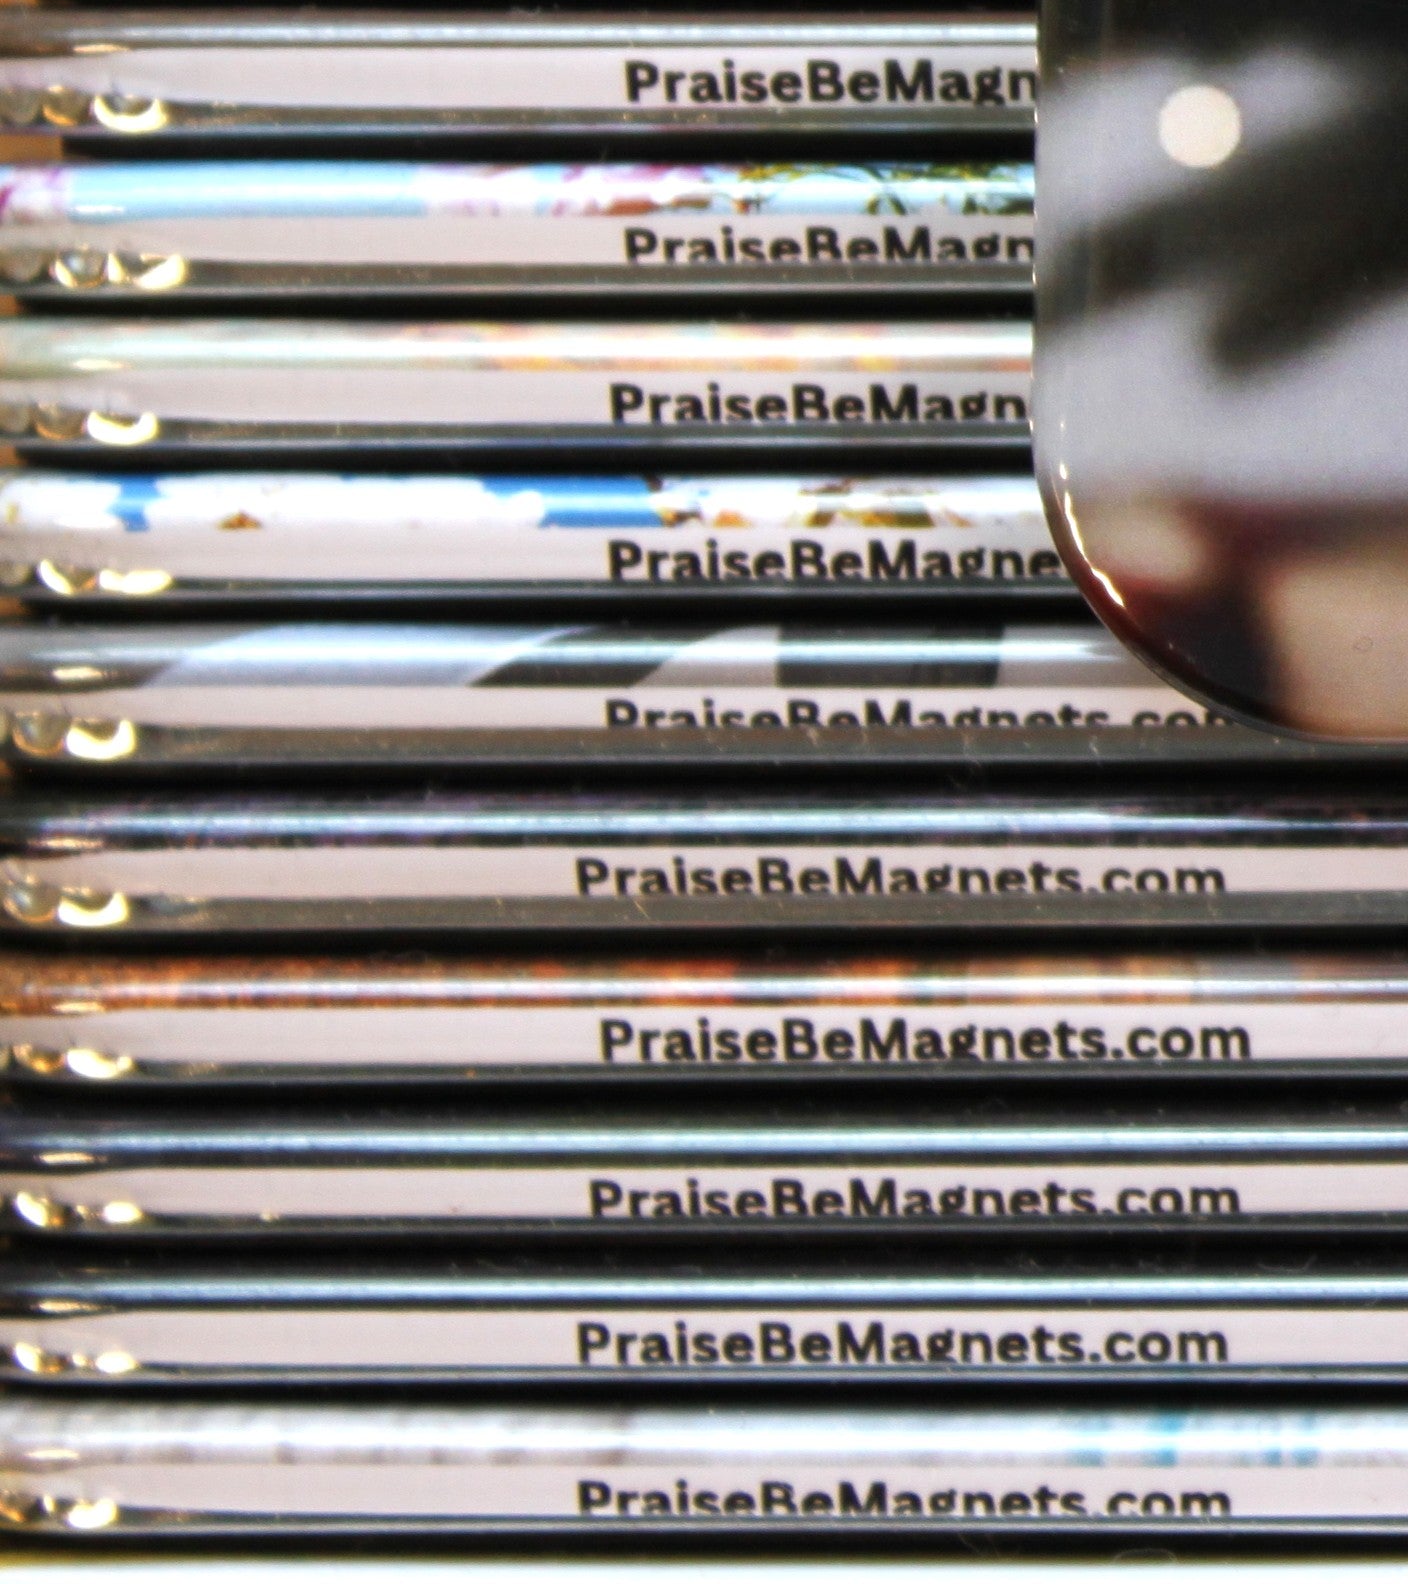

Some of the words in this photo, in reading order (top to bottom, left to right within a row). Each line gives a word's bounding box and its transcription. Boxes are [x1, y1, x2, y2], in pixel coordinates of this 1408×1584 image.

[625, 60, 1036, 107] PraiseBeMagn
[623, 228, 1034, 265] PraiseBeMagn
[611, 383, 1026, 423] PraiseBeMagn
[609, 541, 1065, 579] PraiseBeMagne
[600, 1018, 1250, 1061] PraiseBeMagnets.com
[589, 1179, 1241, 1215] PraiseBeMagnets.com
[577, 1320, 1228, 1364] PraiseBeMagnets.com
